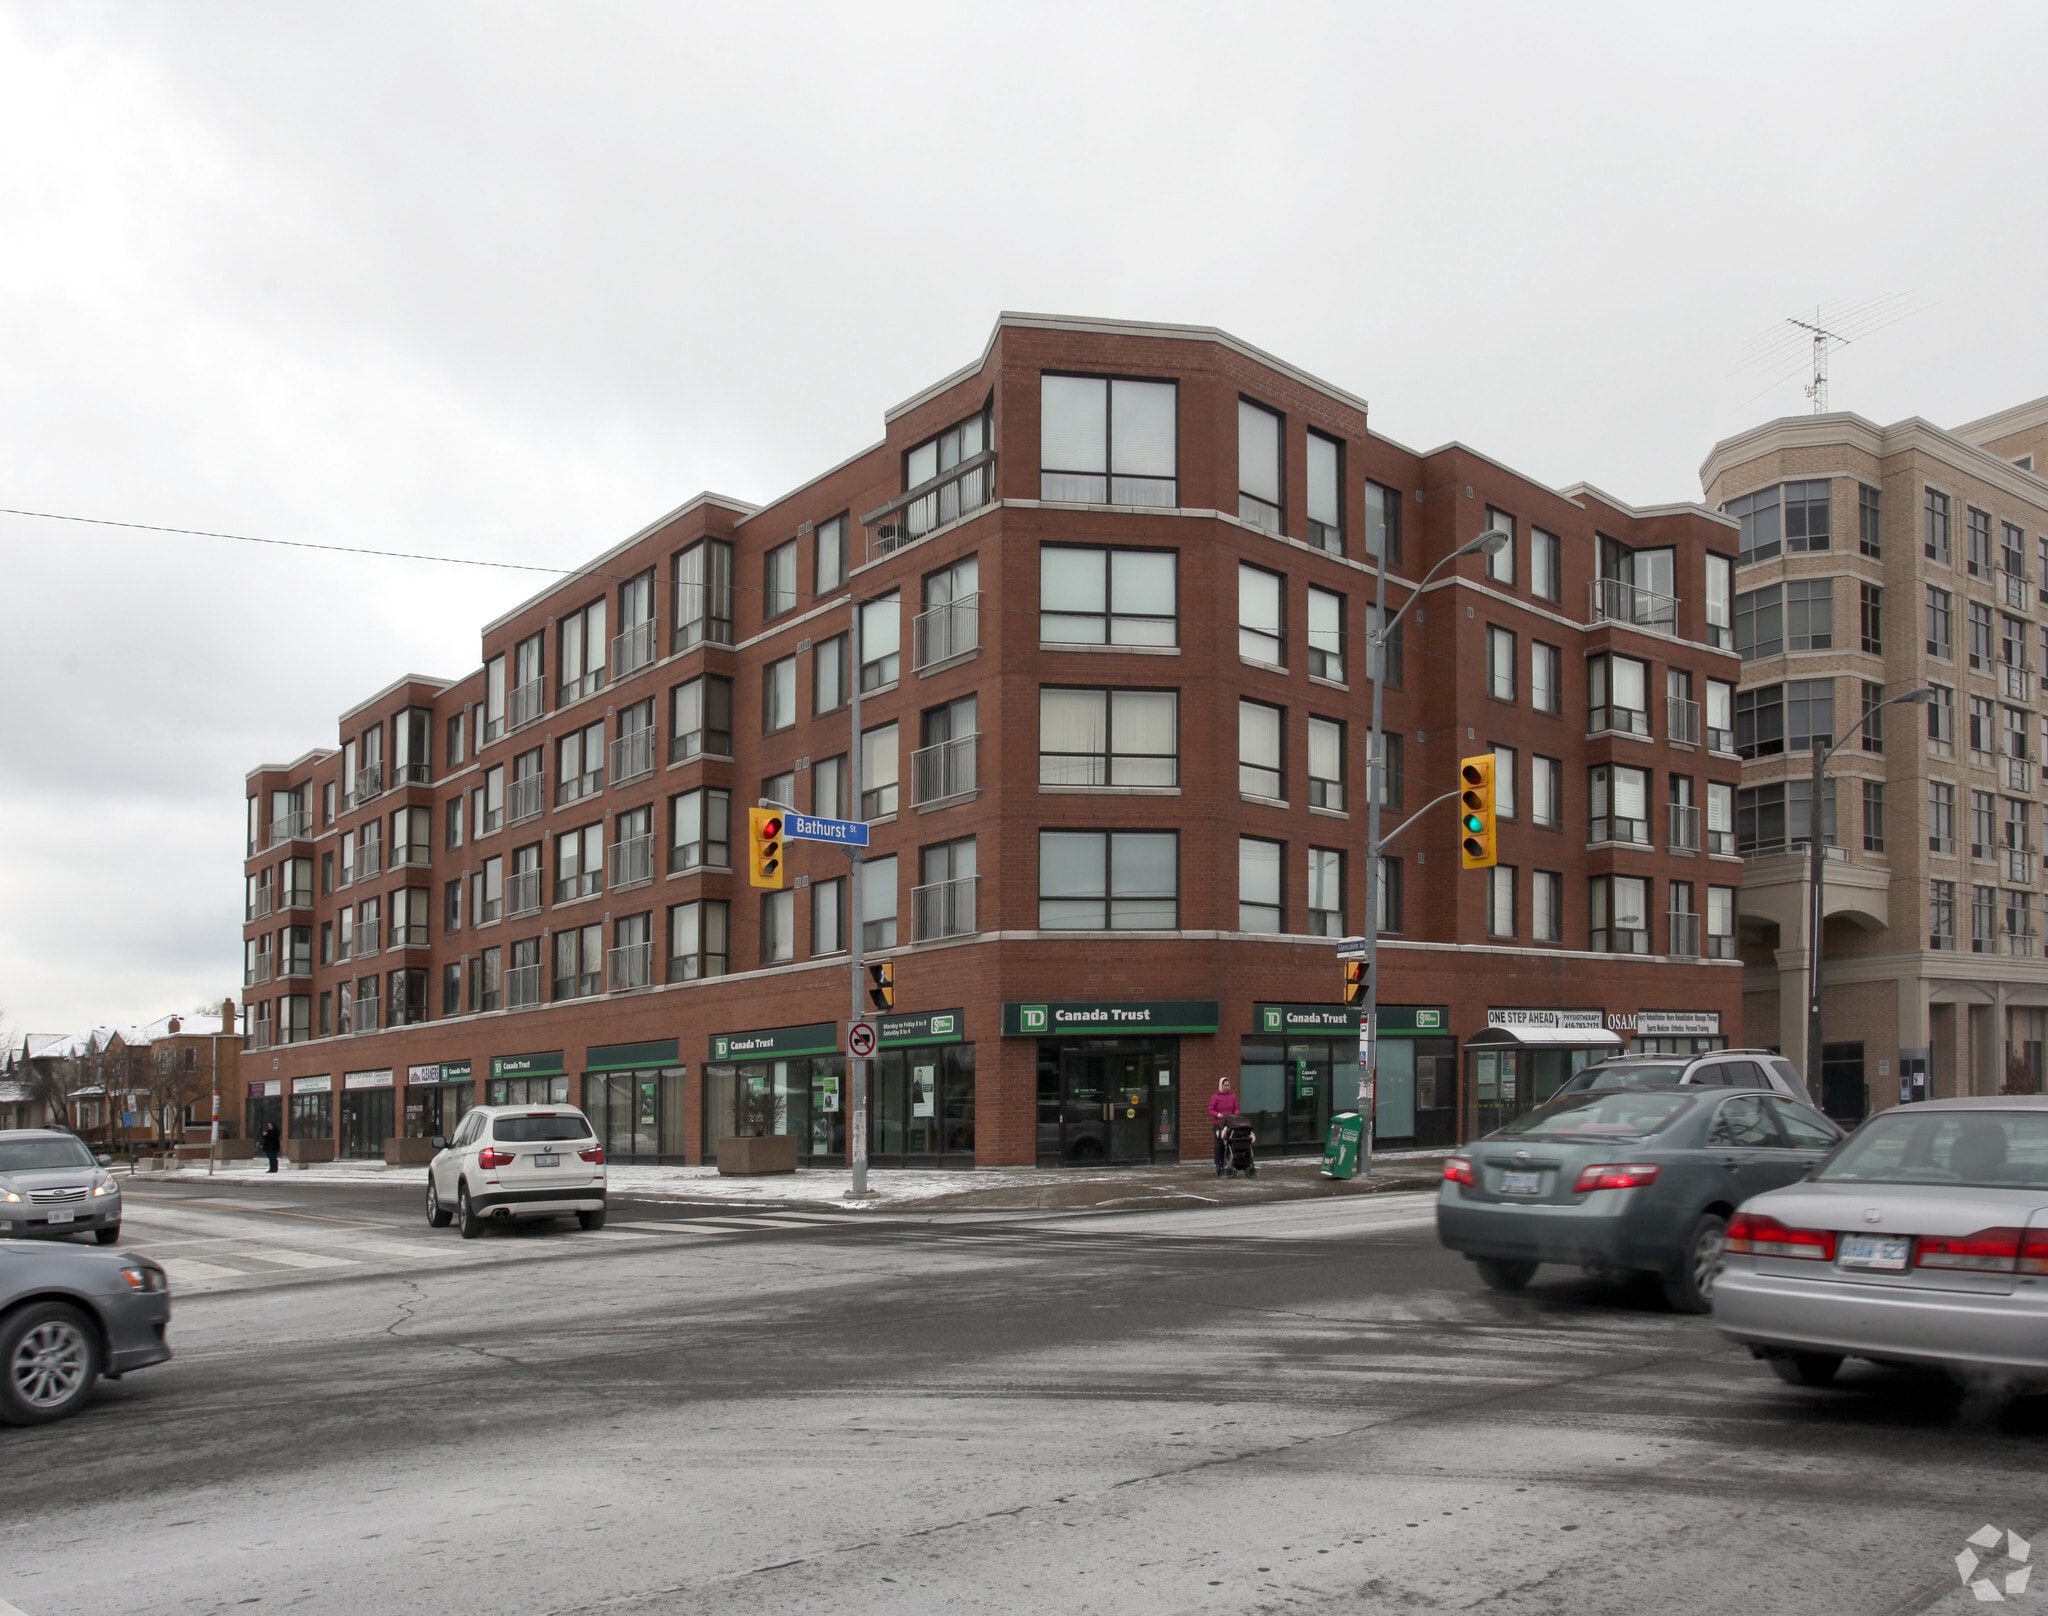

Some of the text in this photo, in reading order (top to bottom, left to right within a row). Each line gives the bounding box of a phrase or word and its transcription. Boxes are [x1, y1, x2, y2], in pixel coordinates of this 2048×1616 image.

[796, 818, 846, 838] Bathurst
[1024, 1011, 1045, 1026] TD
[1055, 1009, 1150, 1021] Canada Trust
[1266, 1012, 1279, 1026] TD
[1286, 1012, 1347, 1024] Canada Trust
[1489, 1012, 1554, 1024] ONE STEP AHEAD
[1607, 1014, 1637, 1030] OSAM
[717, 1042, 727, 1054] TD
[731, 1038, 774, 1050] Canada Trust
[503, 1061, 518, 1070] Canada
[421, 1065, 439, 1081] CLEANERS
